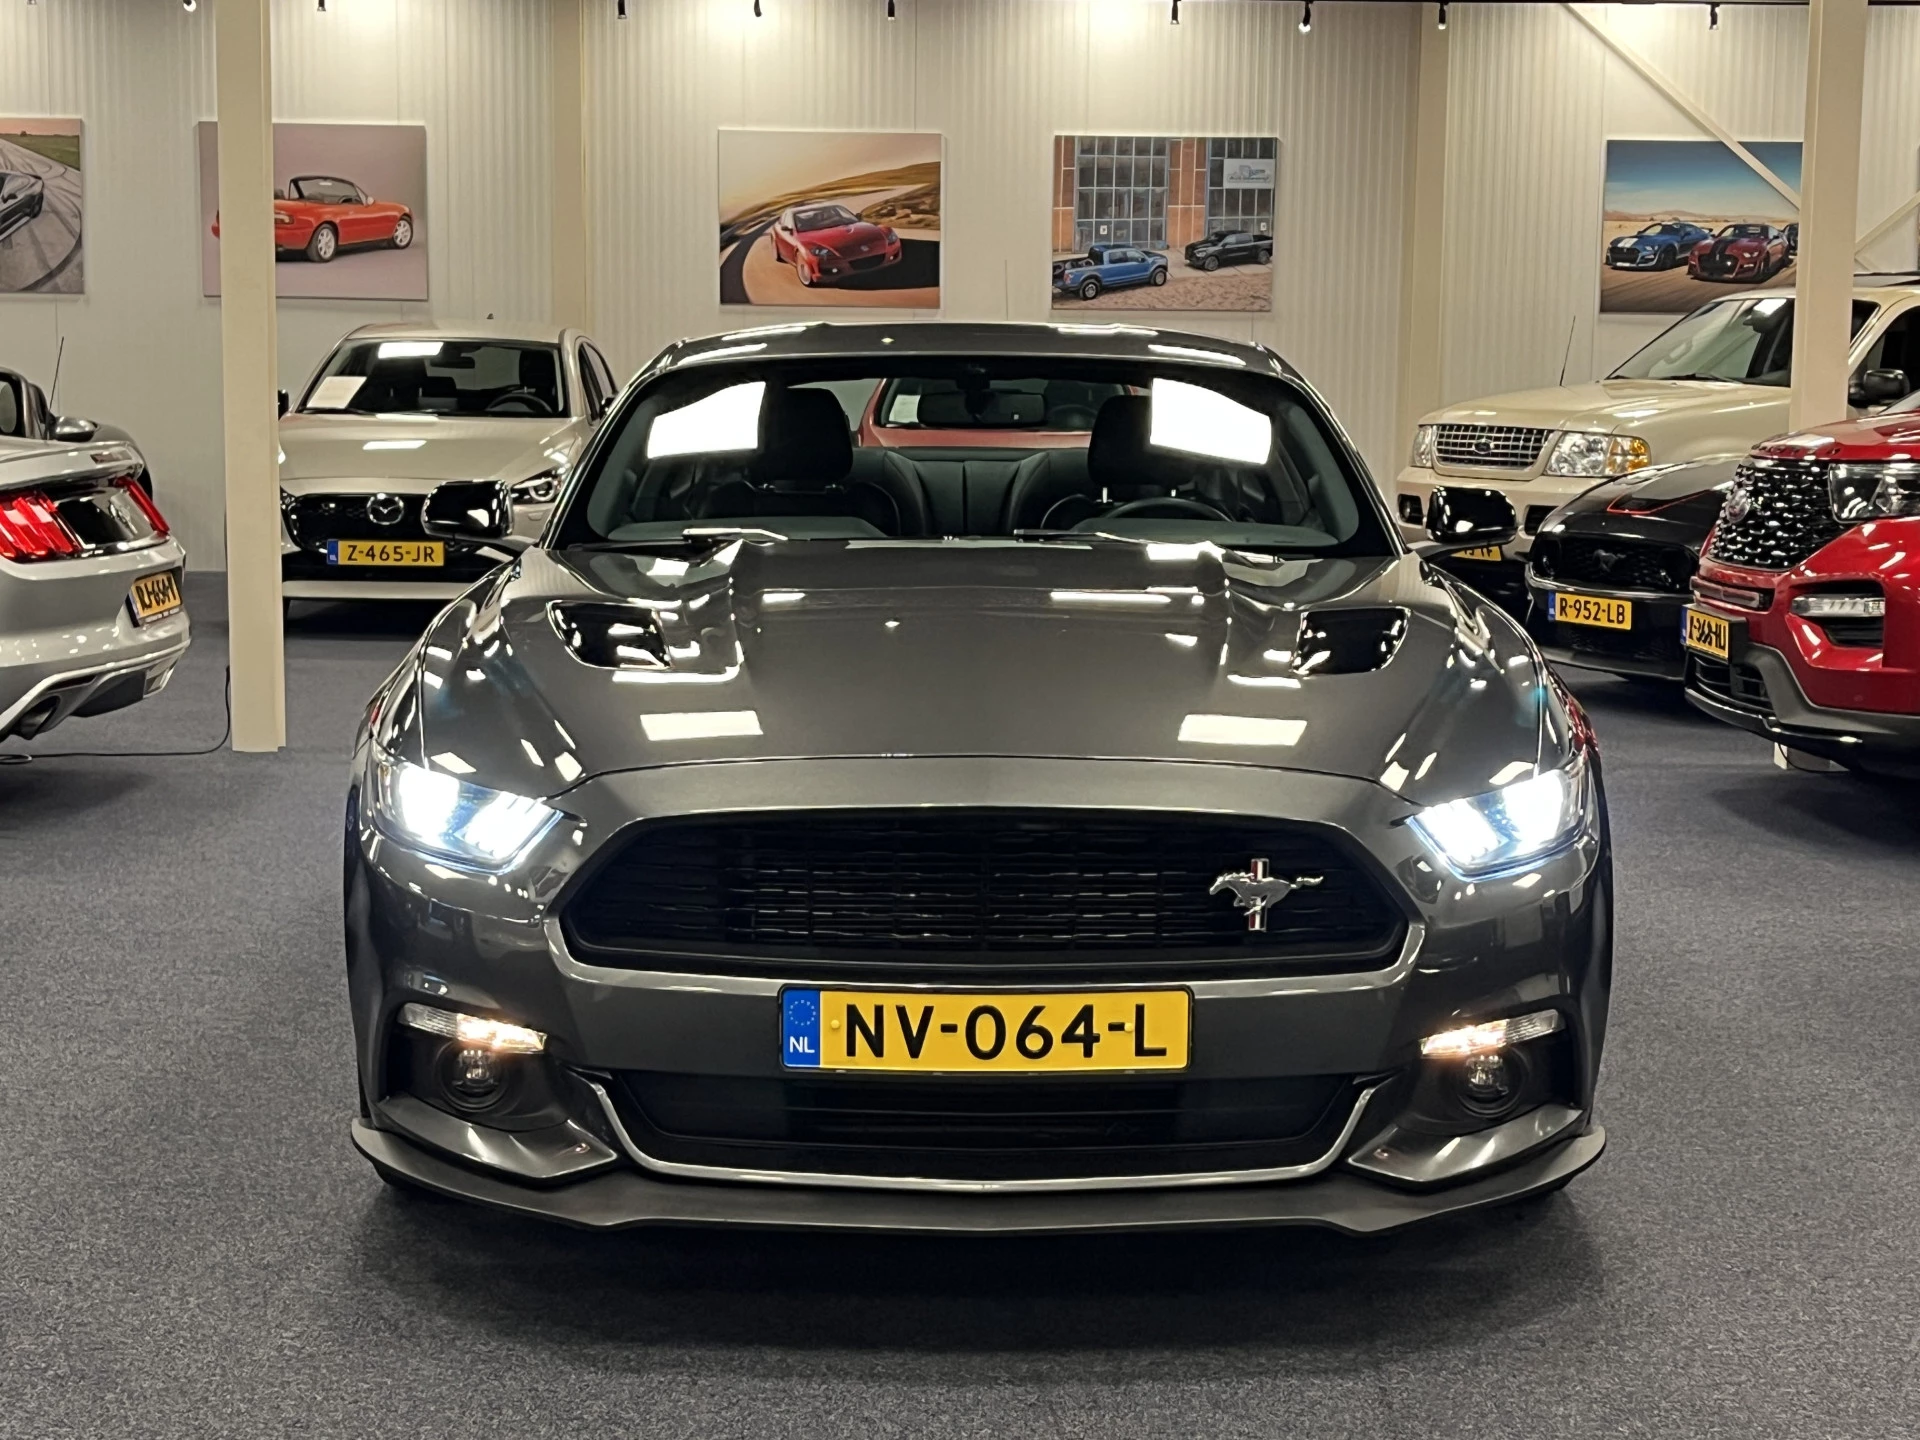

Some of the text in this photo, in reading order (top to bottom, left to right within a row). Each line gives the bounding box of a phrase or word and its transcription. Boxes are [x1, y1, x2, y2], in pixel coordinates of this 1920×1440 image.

[347, 545, 435, 562] Z-465-JR
[1559, 597, 1625, 624] R-952-LB
[845, 1003, 1167, 1060] NV-064-L
[789, 1036, 815, 1053] NL
